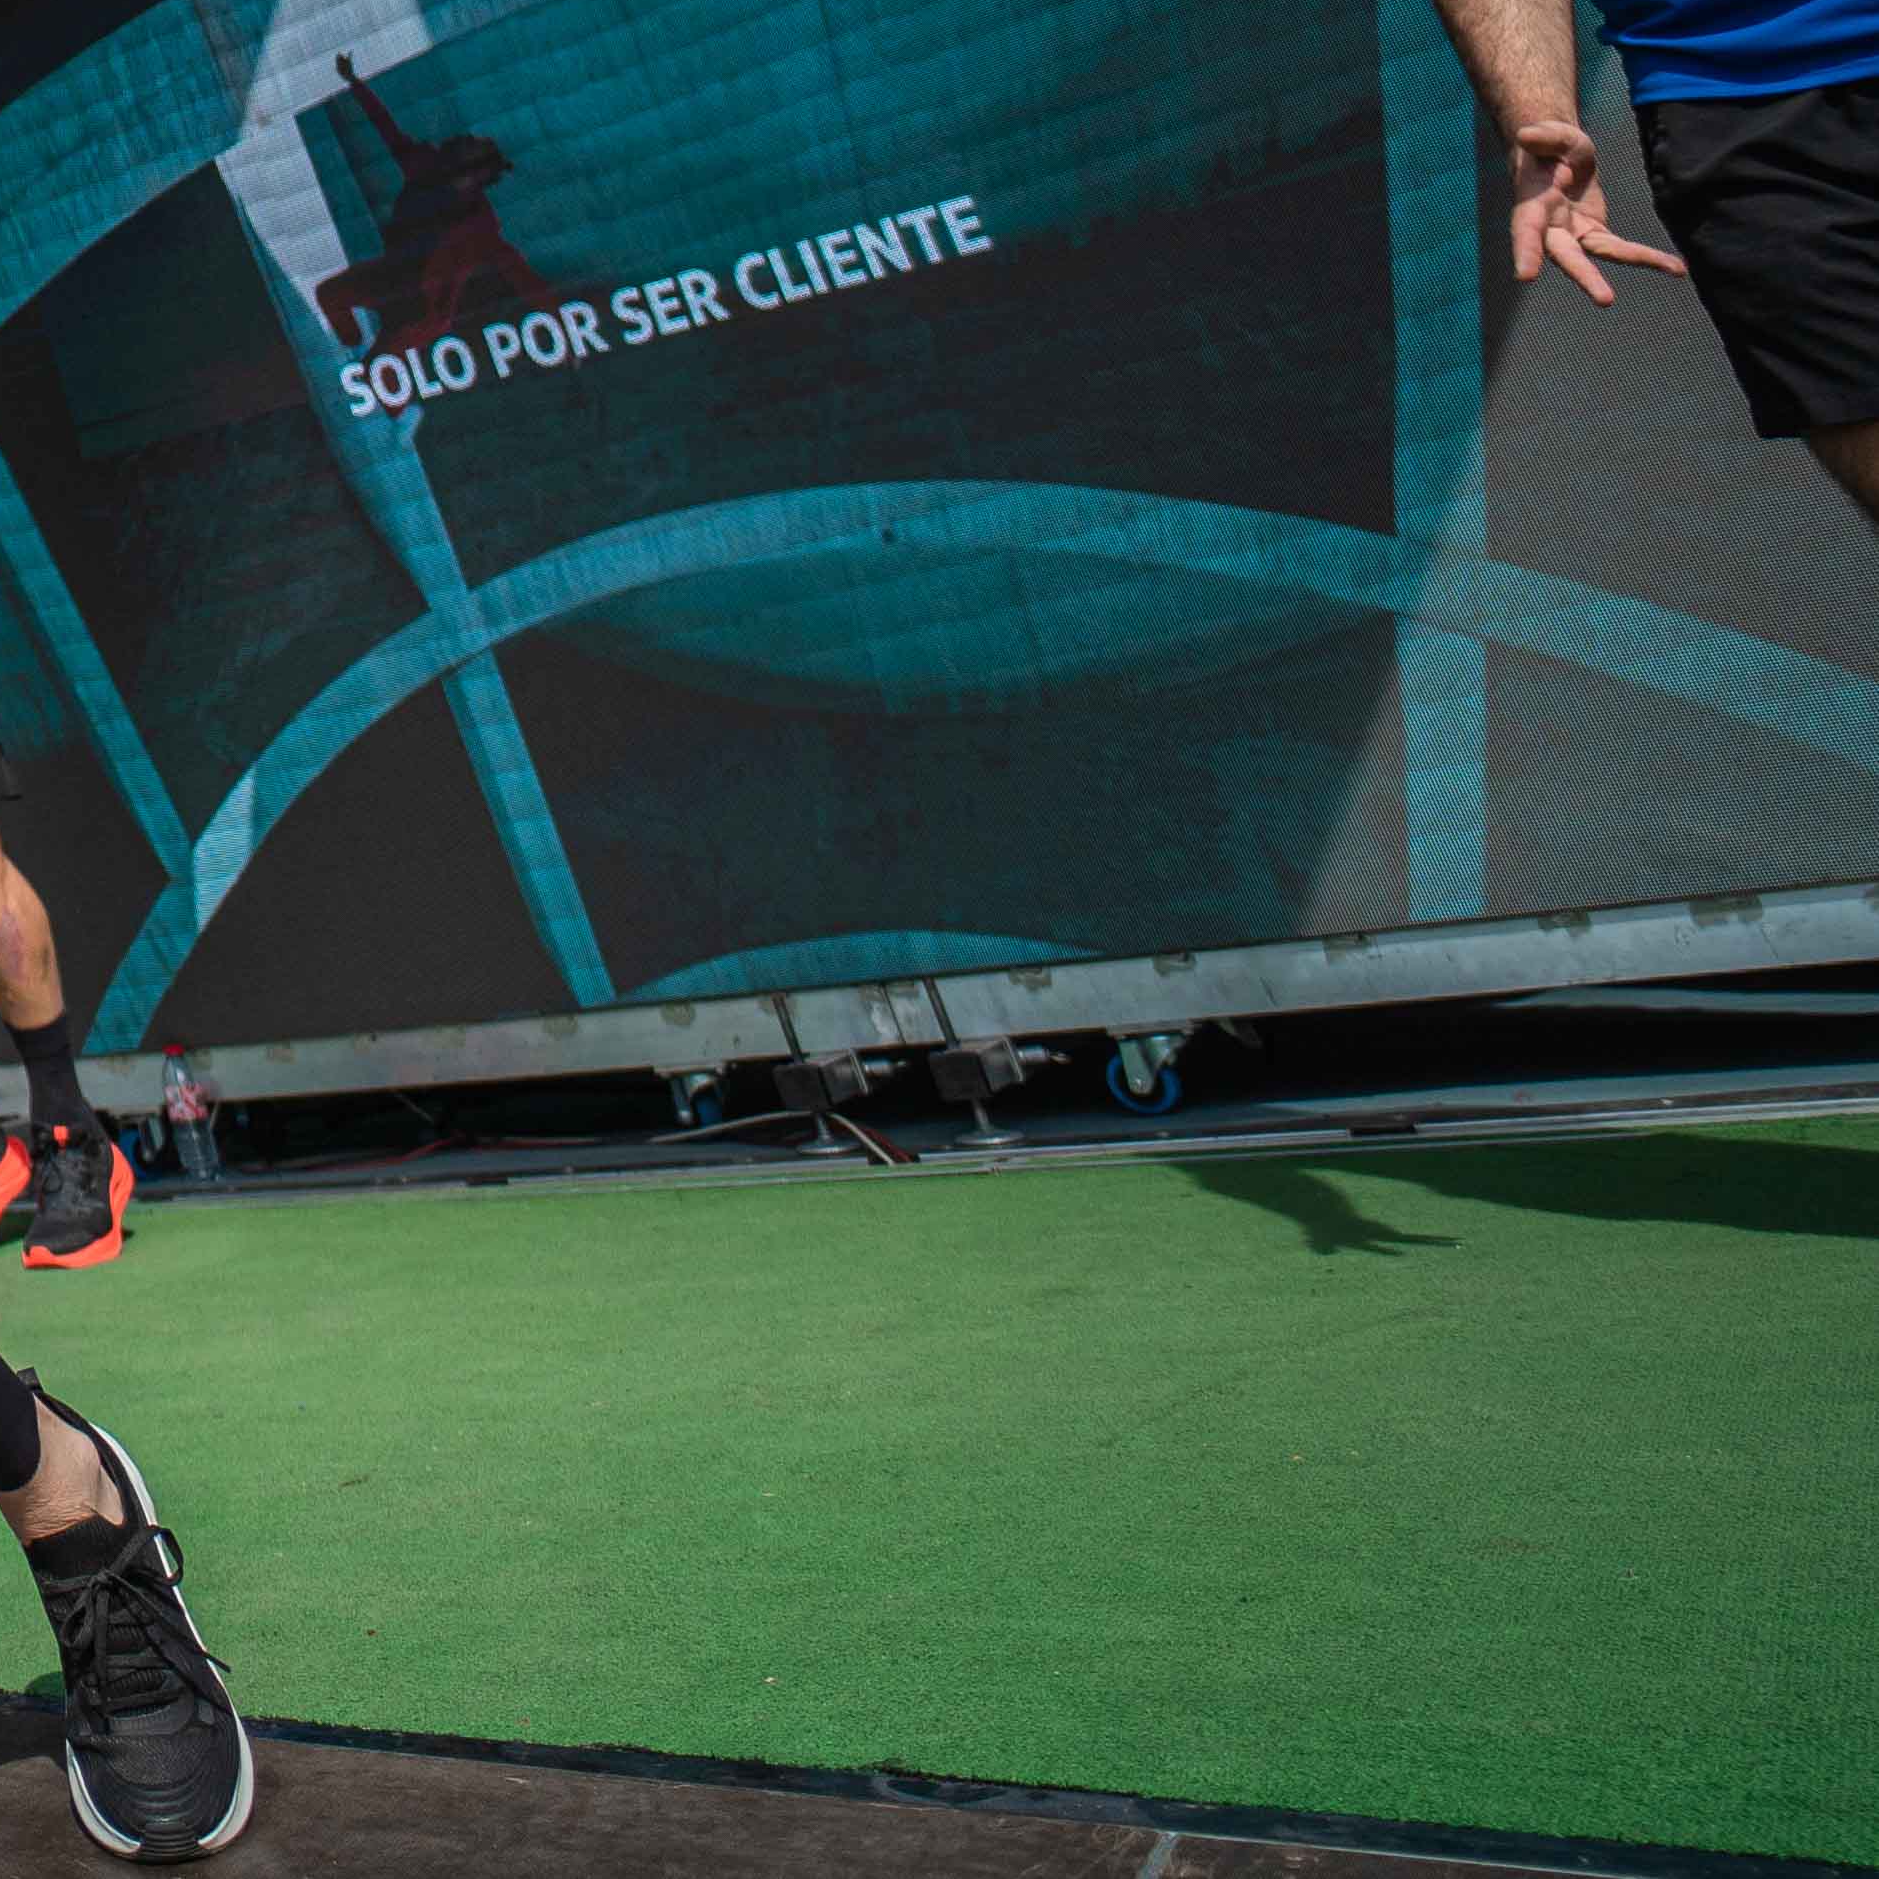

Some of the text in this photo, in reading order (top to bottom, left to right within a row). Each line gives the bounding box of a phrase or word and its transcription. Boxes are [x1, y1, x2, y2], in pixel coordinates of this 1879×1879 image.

[340, 194, 993, 417] SOLO POR SER CLIENTE
